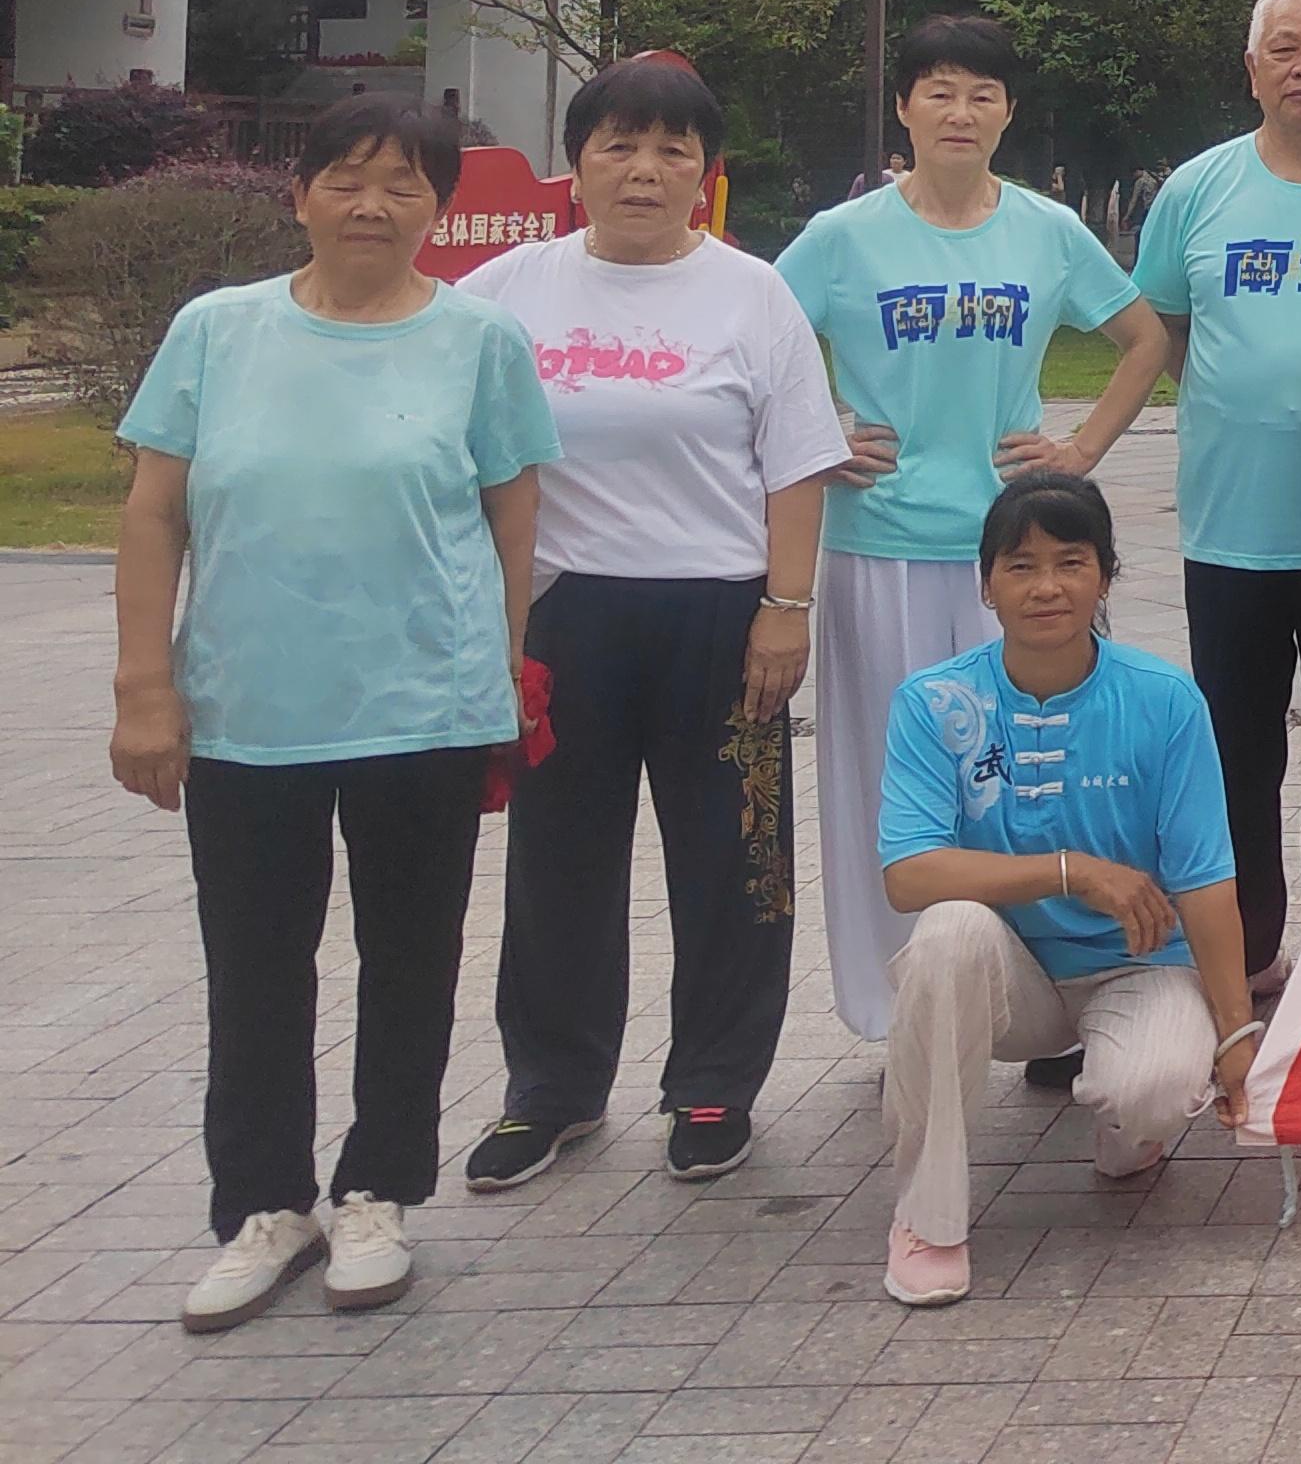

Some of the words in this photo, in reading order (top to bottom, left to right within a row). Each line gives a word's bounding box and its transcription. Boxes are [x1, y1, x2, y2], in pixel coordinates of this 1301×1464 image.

[431, 212, 557, 247] 总体国家安全观
[876, 281, 1030, 351] 南城
[974, 742, 1013, 787] 武
